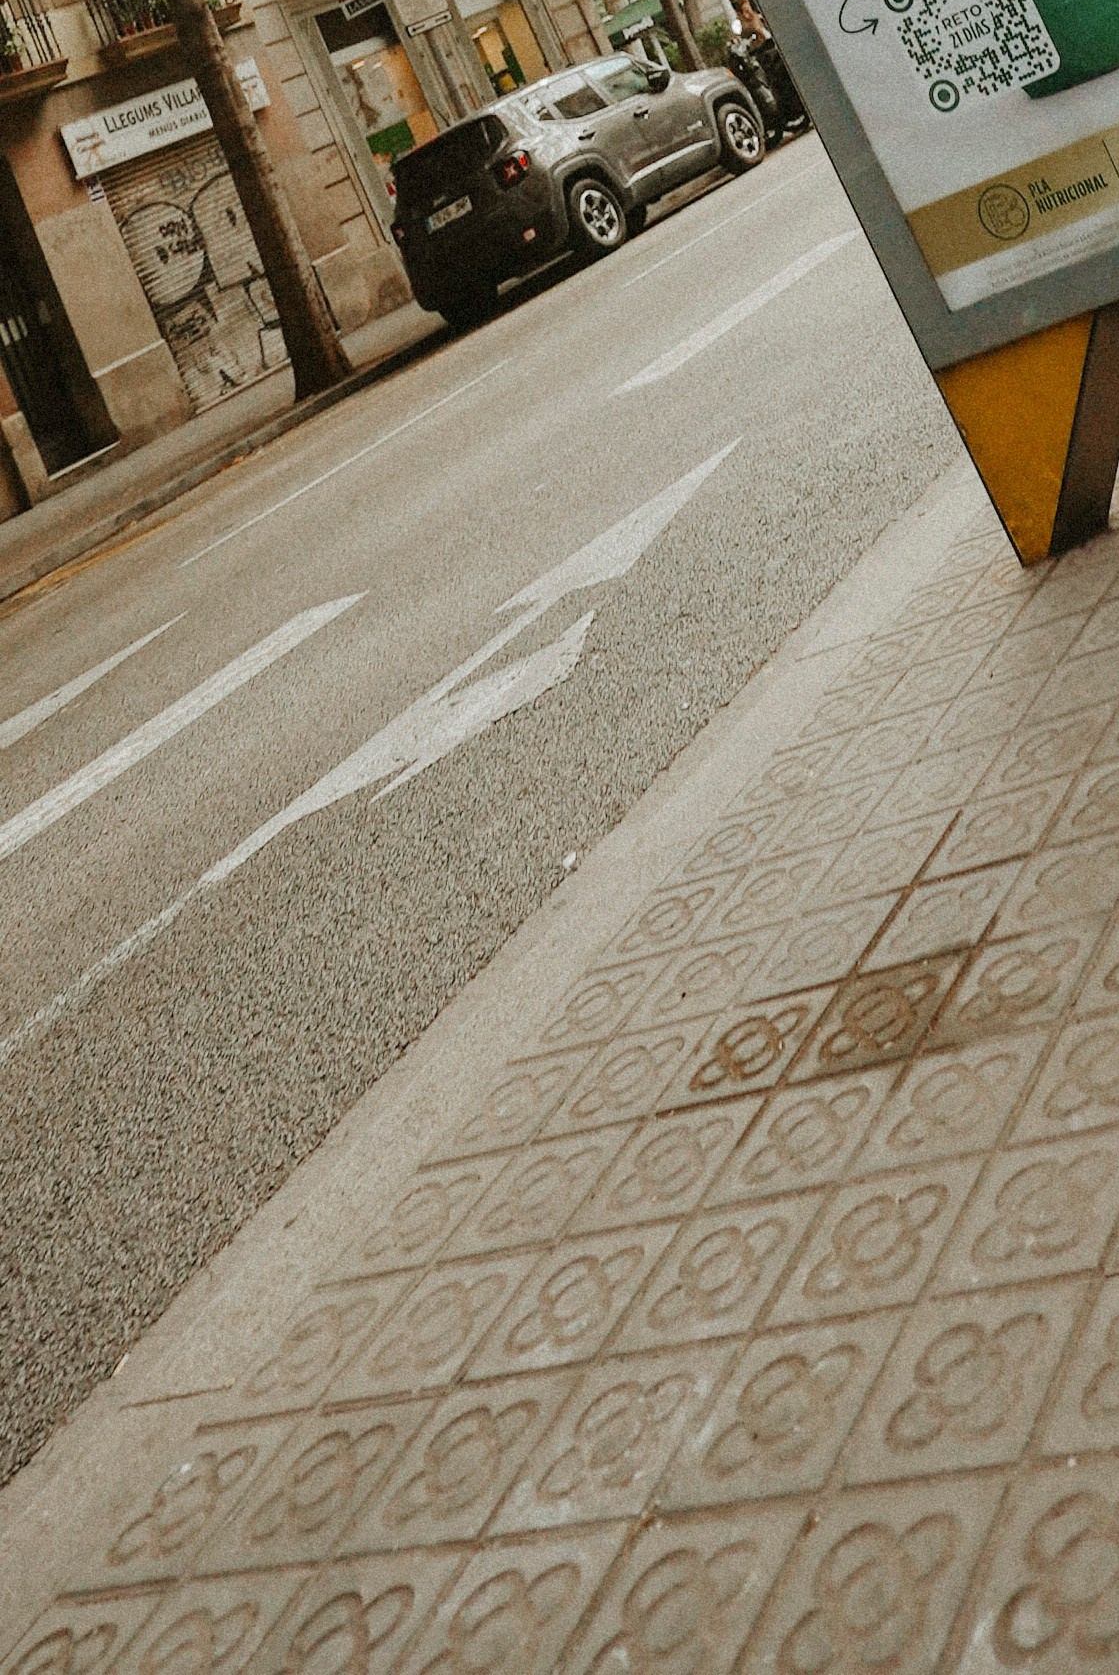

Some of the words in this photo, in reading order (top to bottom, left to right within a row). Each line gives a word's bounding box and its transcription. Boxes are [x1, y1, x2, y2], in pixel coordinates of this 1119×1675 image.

[942, 4, 982, 31] RETO
[948, 29, 964, 49] 21
[103, 101, 162, 133] LLEGUMS
[1028, 179, 1052, 199] PLA
[1035, 174, 1109, 215] NUTRICIONAL
